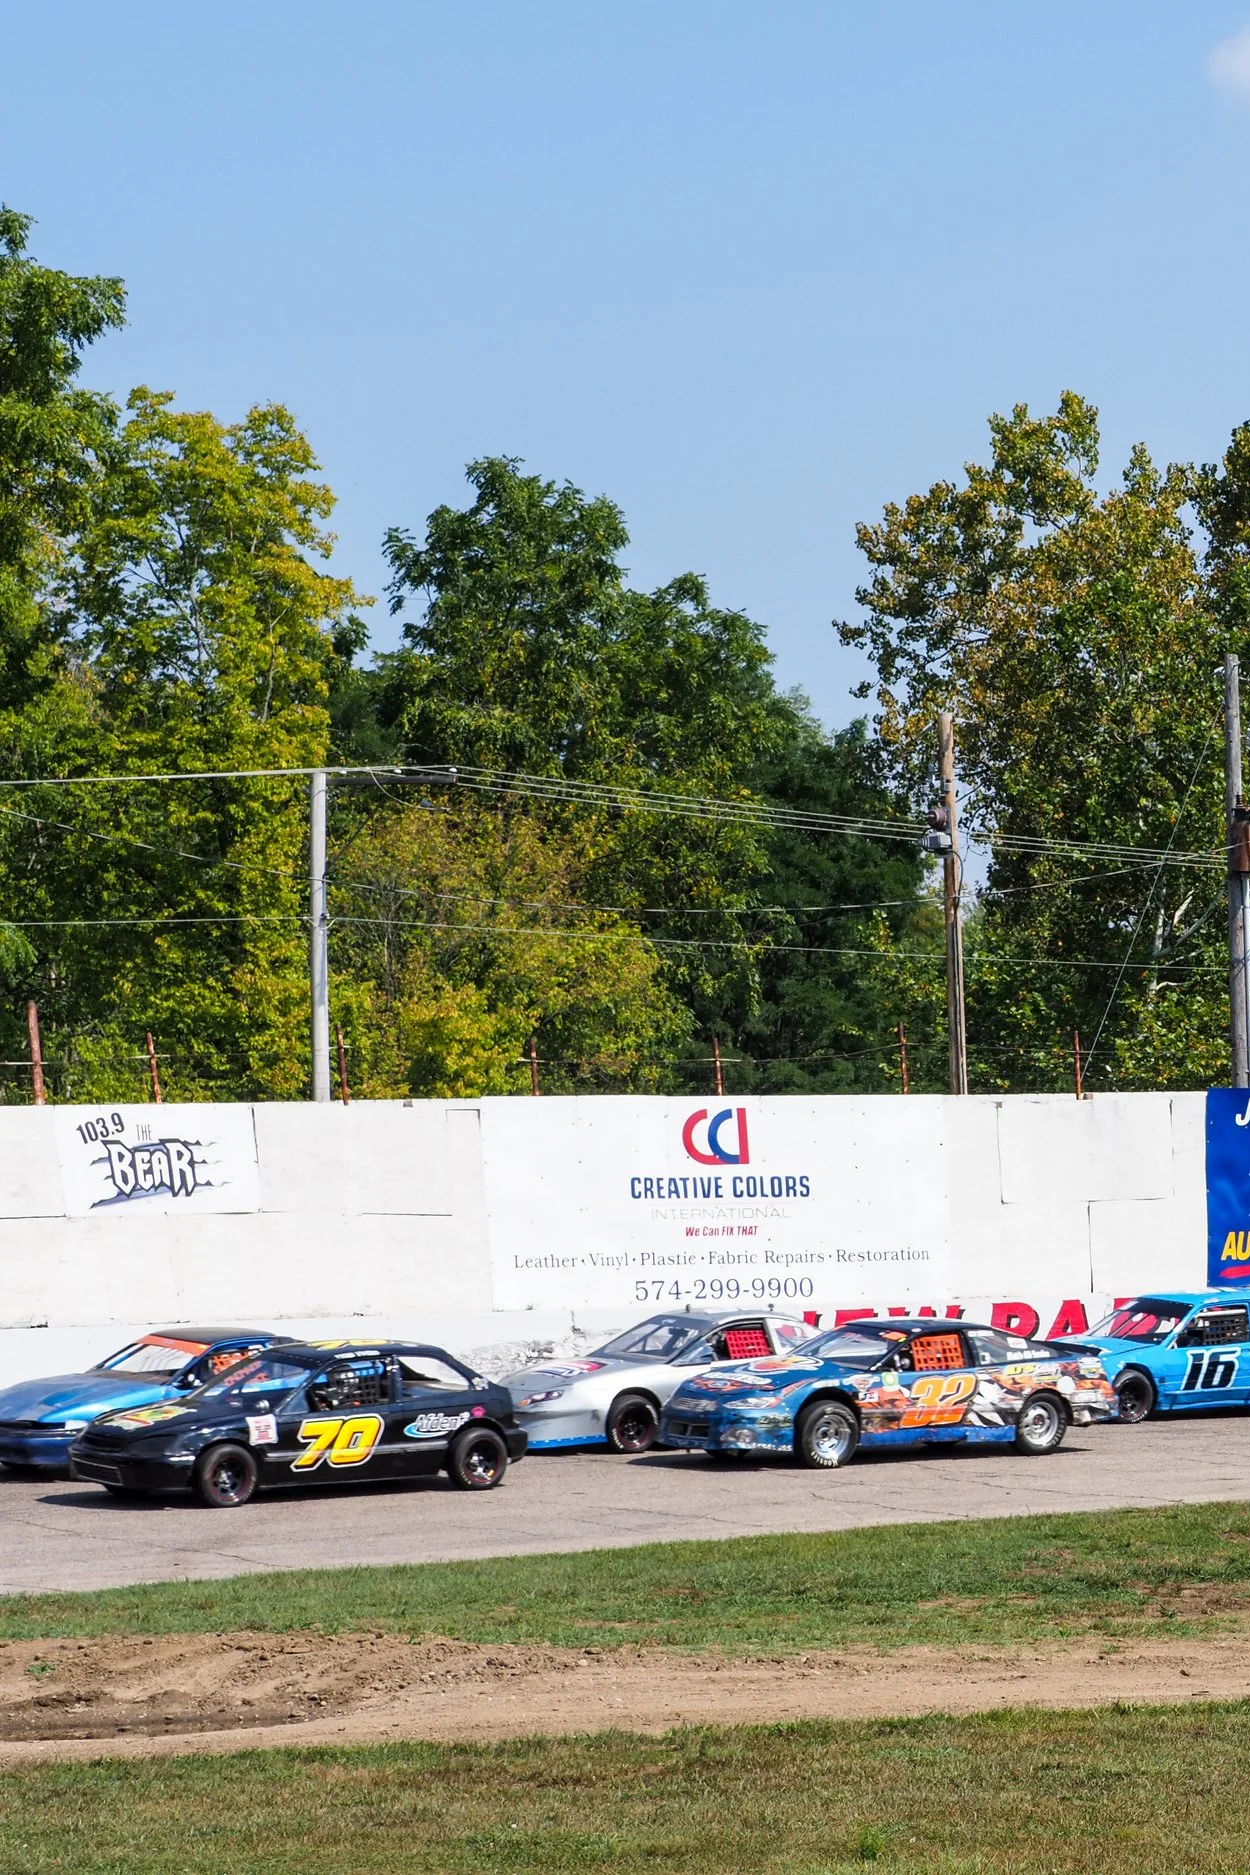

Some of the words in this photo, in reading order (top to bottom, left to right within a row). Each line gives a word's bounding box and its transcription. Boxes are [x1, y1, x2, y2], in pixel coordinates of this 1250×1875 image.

[75, 1112, 125, 1144] 103.9
[136, 1124, 152, 1141] THE
[100, 1138, 198, 1198] BEAR
[630, 1177, 724, 1199] CREATIVE
[732, 1175, 811, 1198] COLORS
[652, 1206, 791, 1221] INTERNATIONAL
[685, 1226, 700, 1237] We
[702, 1225, 720, 1237] Can
[722, 1225, 735, 1236] FIX
[737, 1225, 758, 1236] THAT
[514, 1253, 578, 1269] Leather
[589, 1252, 629, 1270] Vinyl
[640, 1251, 697, 1267] Plastic
[708, 1249, 758, 1265] Fabric
[764, 1249, 825, 1268] Repairs
[836, 1247, 930, 1263] Restoration
[635, 1276, 814, 1301] 574-299-9900
[1180, 1346, 1242, 1392] 16
[900, 1372, 980, 1429] 32
[290, 1412, 385, 1472] 70
